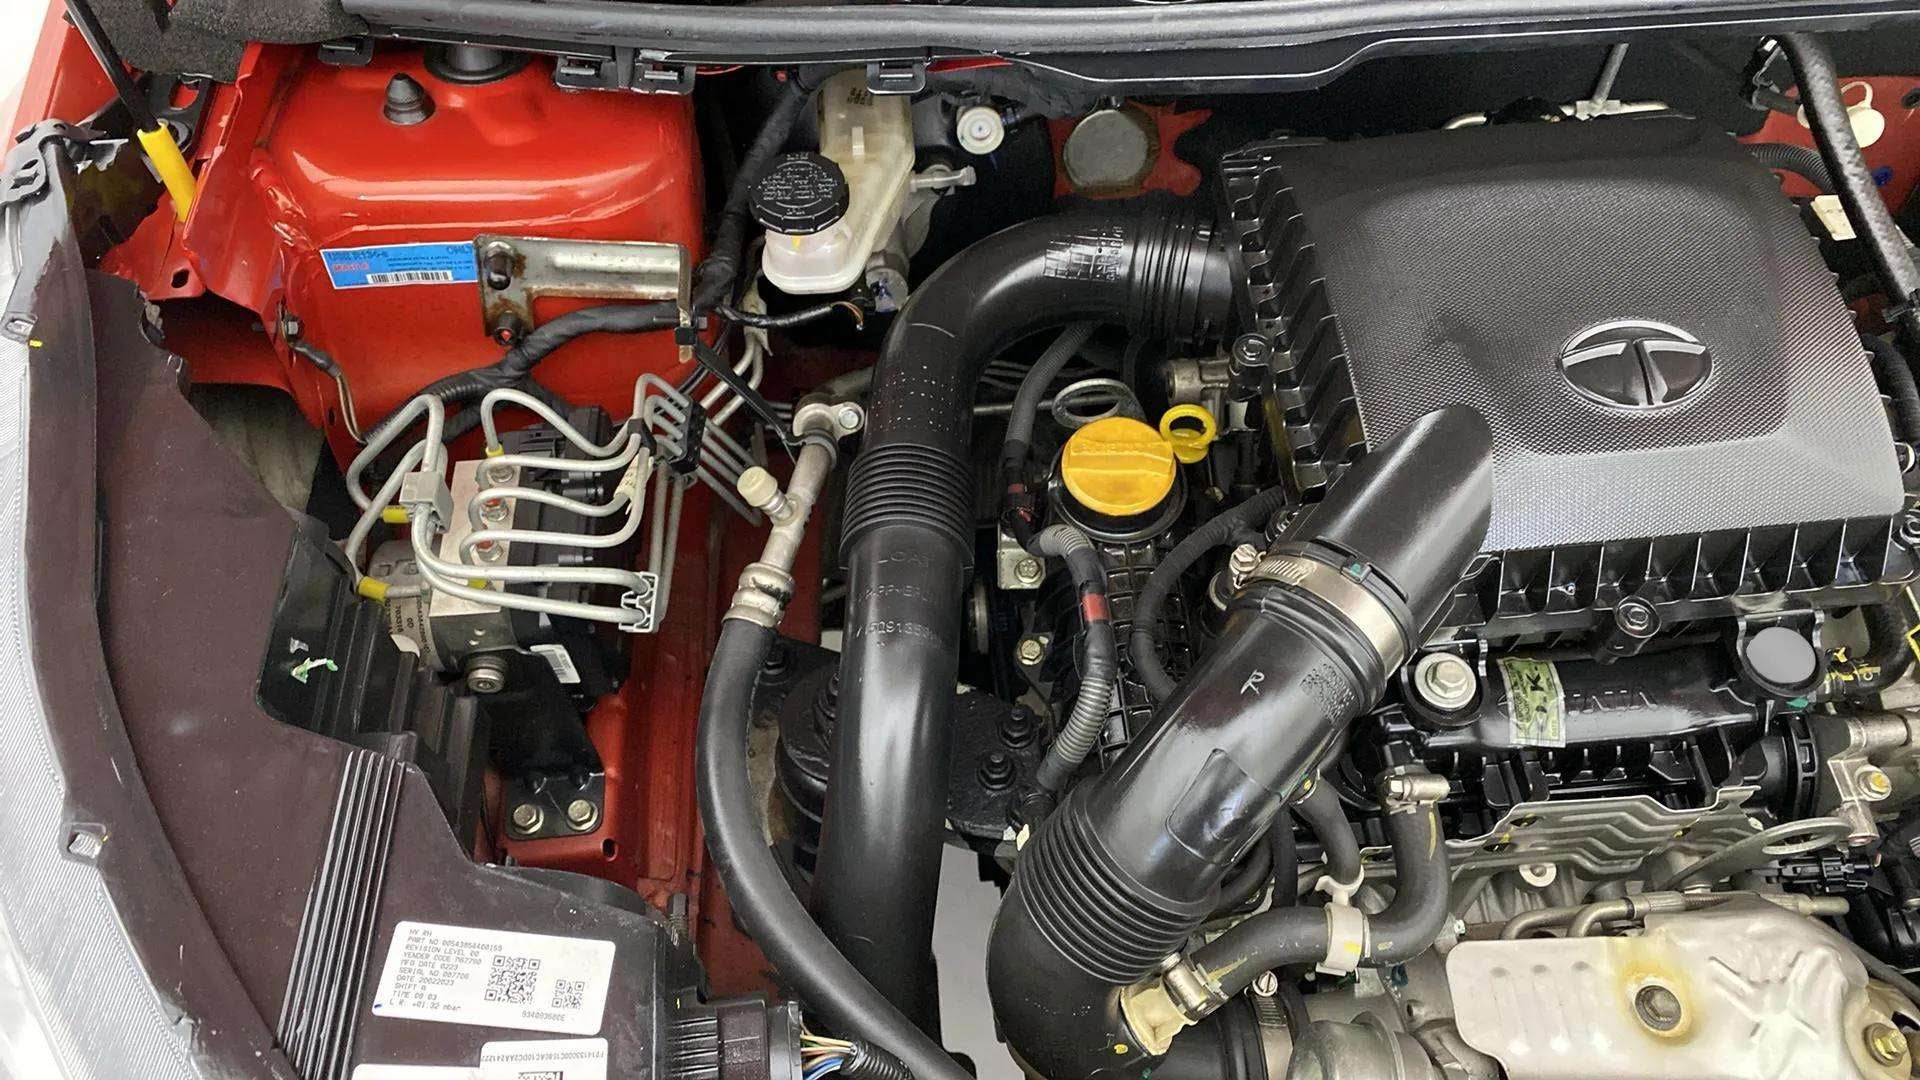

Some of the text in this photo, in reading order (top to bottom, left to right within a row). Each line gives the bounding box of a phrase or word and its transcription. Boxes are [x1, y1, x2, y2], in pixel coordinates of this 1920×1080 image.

[406, 936, 425, 944] PART
[404, 943, 440, 953] REVISION
[443, 947, 466, 955] LEVEL
[432, 954, 452, 962] CODE
[418, 960, 436, 968] DATE
[398, 966, 425, 975] SERIAL
[396, 974, 415, 982] DATE
[394, 982, 417, 990] SHIFT
[391, 990, 410, 998] TIME
